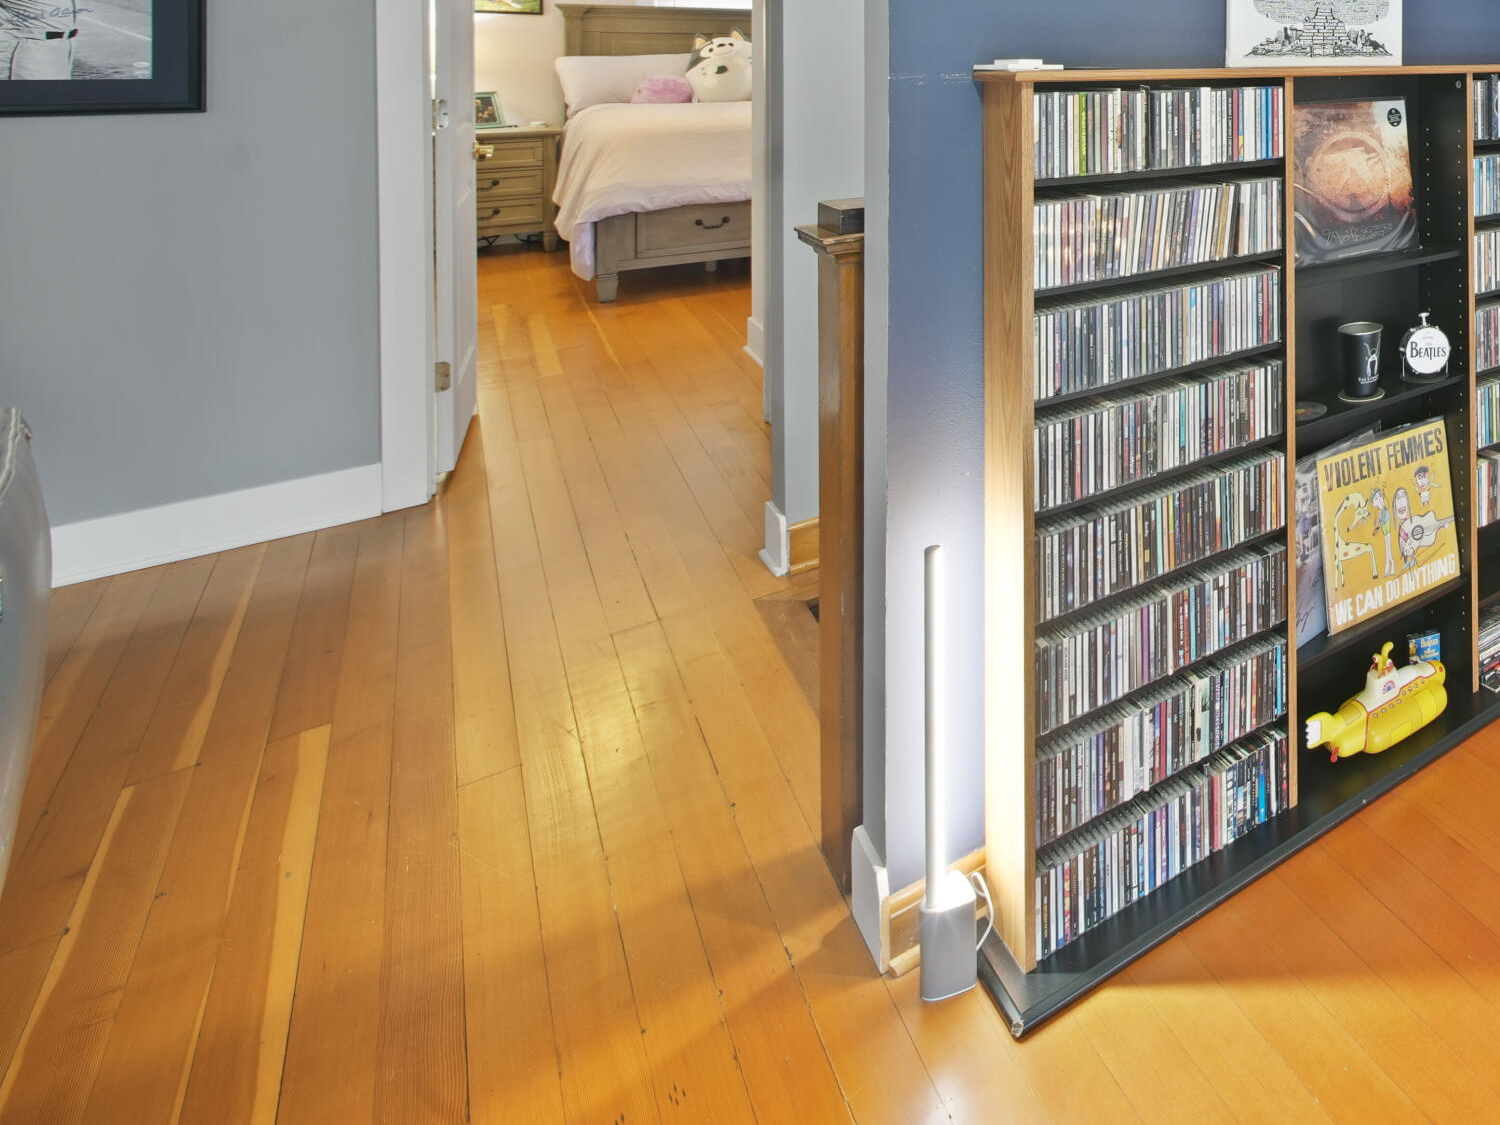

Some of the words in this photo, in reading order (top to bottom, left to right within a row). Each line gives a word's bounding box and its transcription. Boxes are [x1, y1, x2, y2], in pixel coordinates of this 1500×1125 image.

[1410, 341, 1447, 360] BEATLES
[1324, 446, 1382, 492] VIOLENT
[1387, 428, 1444, 471] FEMMES
[1335, 601, 1354, 625] WE
[1355, 585, 1384, 616] CAN
[1385, 578, 1400, 601] DO
[1402, 553, 1456, 591] ANYTHING
